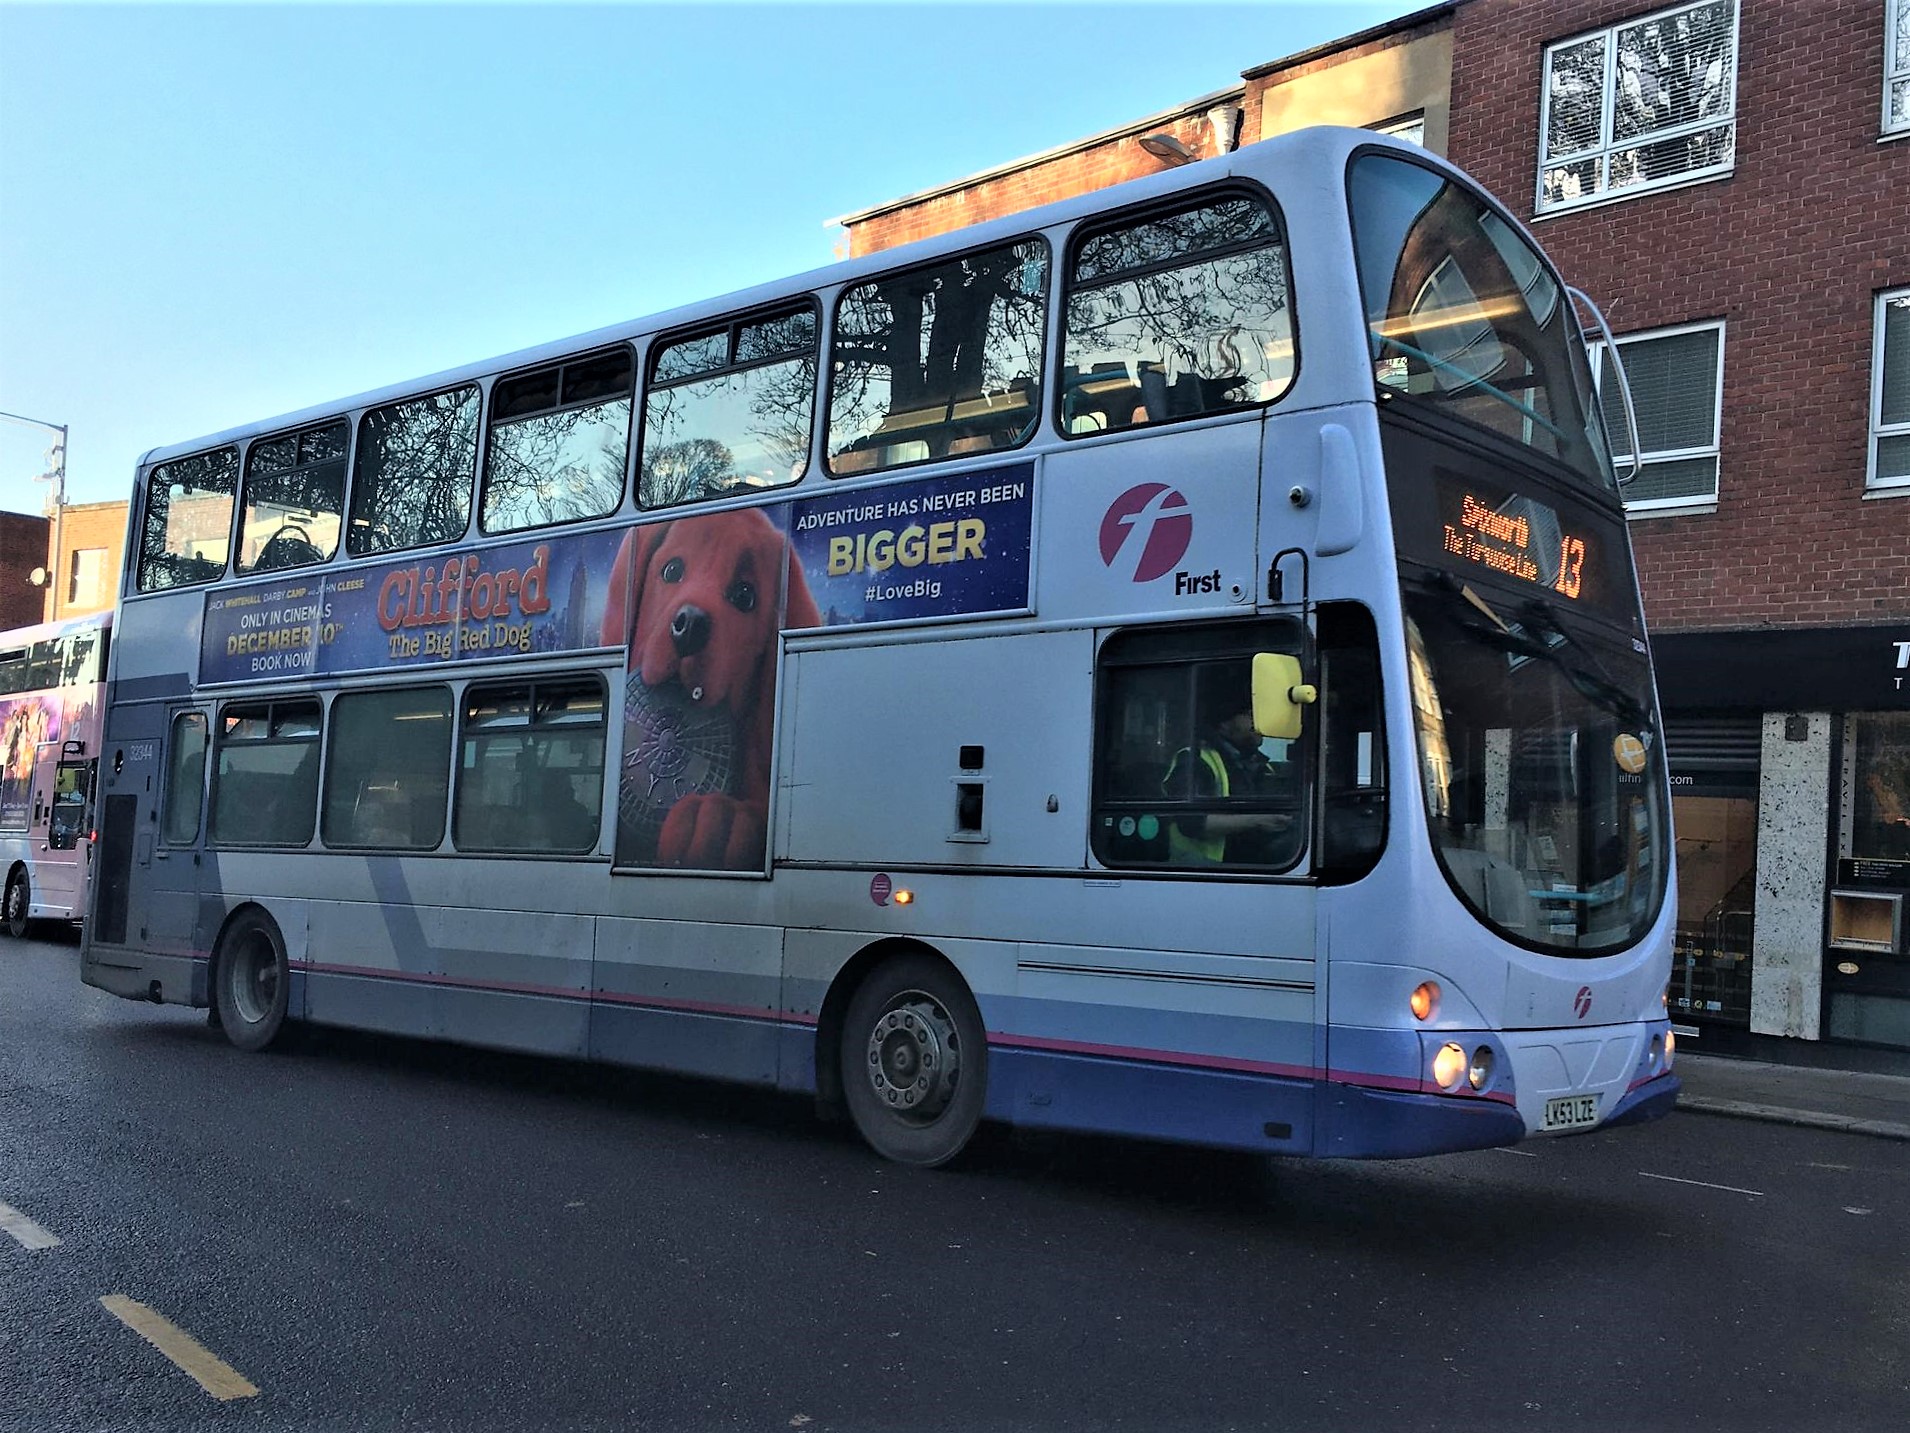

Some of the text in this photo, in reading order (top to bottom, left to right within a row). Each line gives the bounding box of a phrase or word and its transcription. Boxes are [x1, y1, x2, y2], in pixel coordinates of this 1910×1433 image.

[797, 483, 1025, 530] ADVENTURE HAS NEVER BEEN
[827, 518, 986, 577] BIGGER
[1556, 535, 1585, 599] 13
[316, 583, 336, 596] JHN
[377, 544, 550, 632] Clifford
[865, 580, 941, 602] #LoveBig
[1175, 569, 1221, 596] First
[240, 603, 332, 629] ONLY IN CINEMAS
[227, 626, 312, 656] DECEMBER
[389, 621, 532, 659] The Big Red Dog
[251, 651, 312, 672] BOOK NOW
